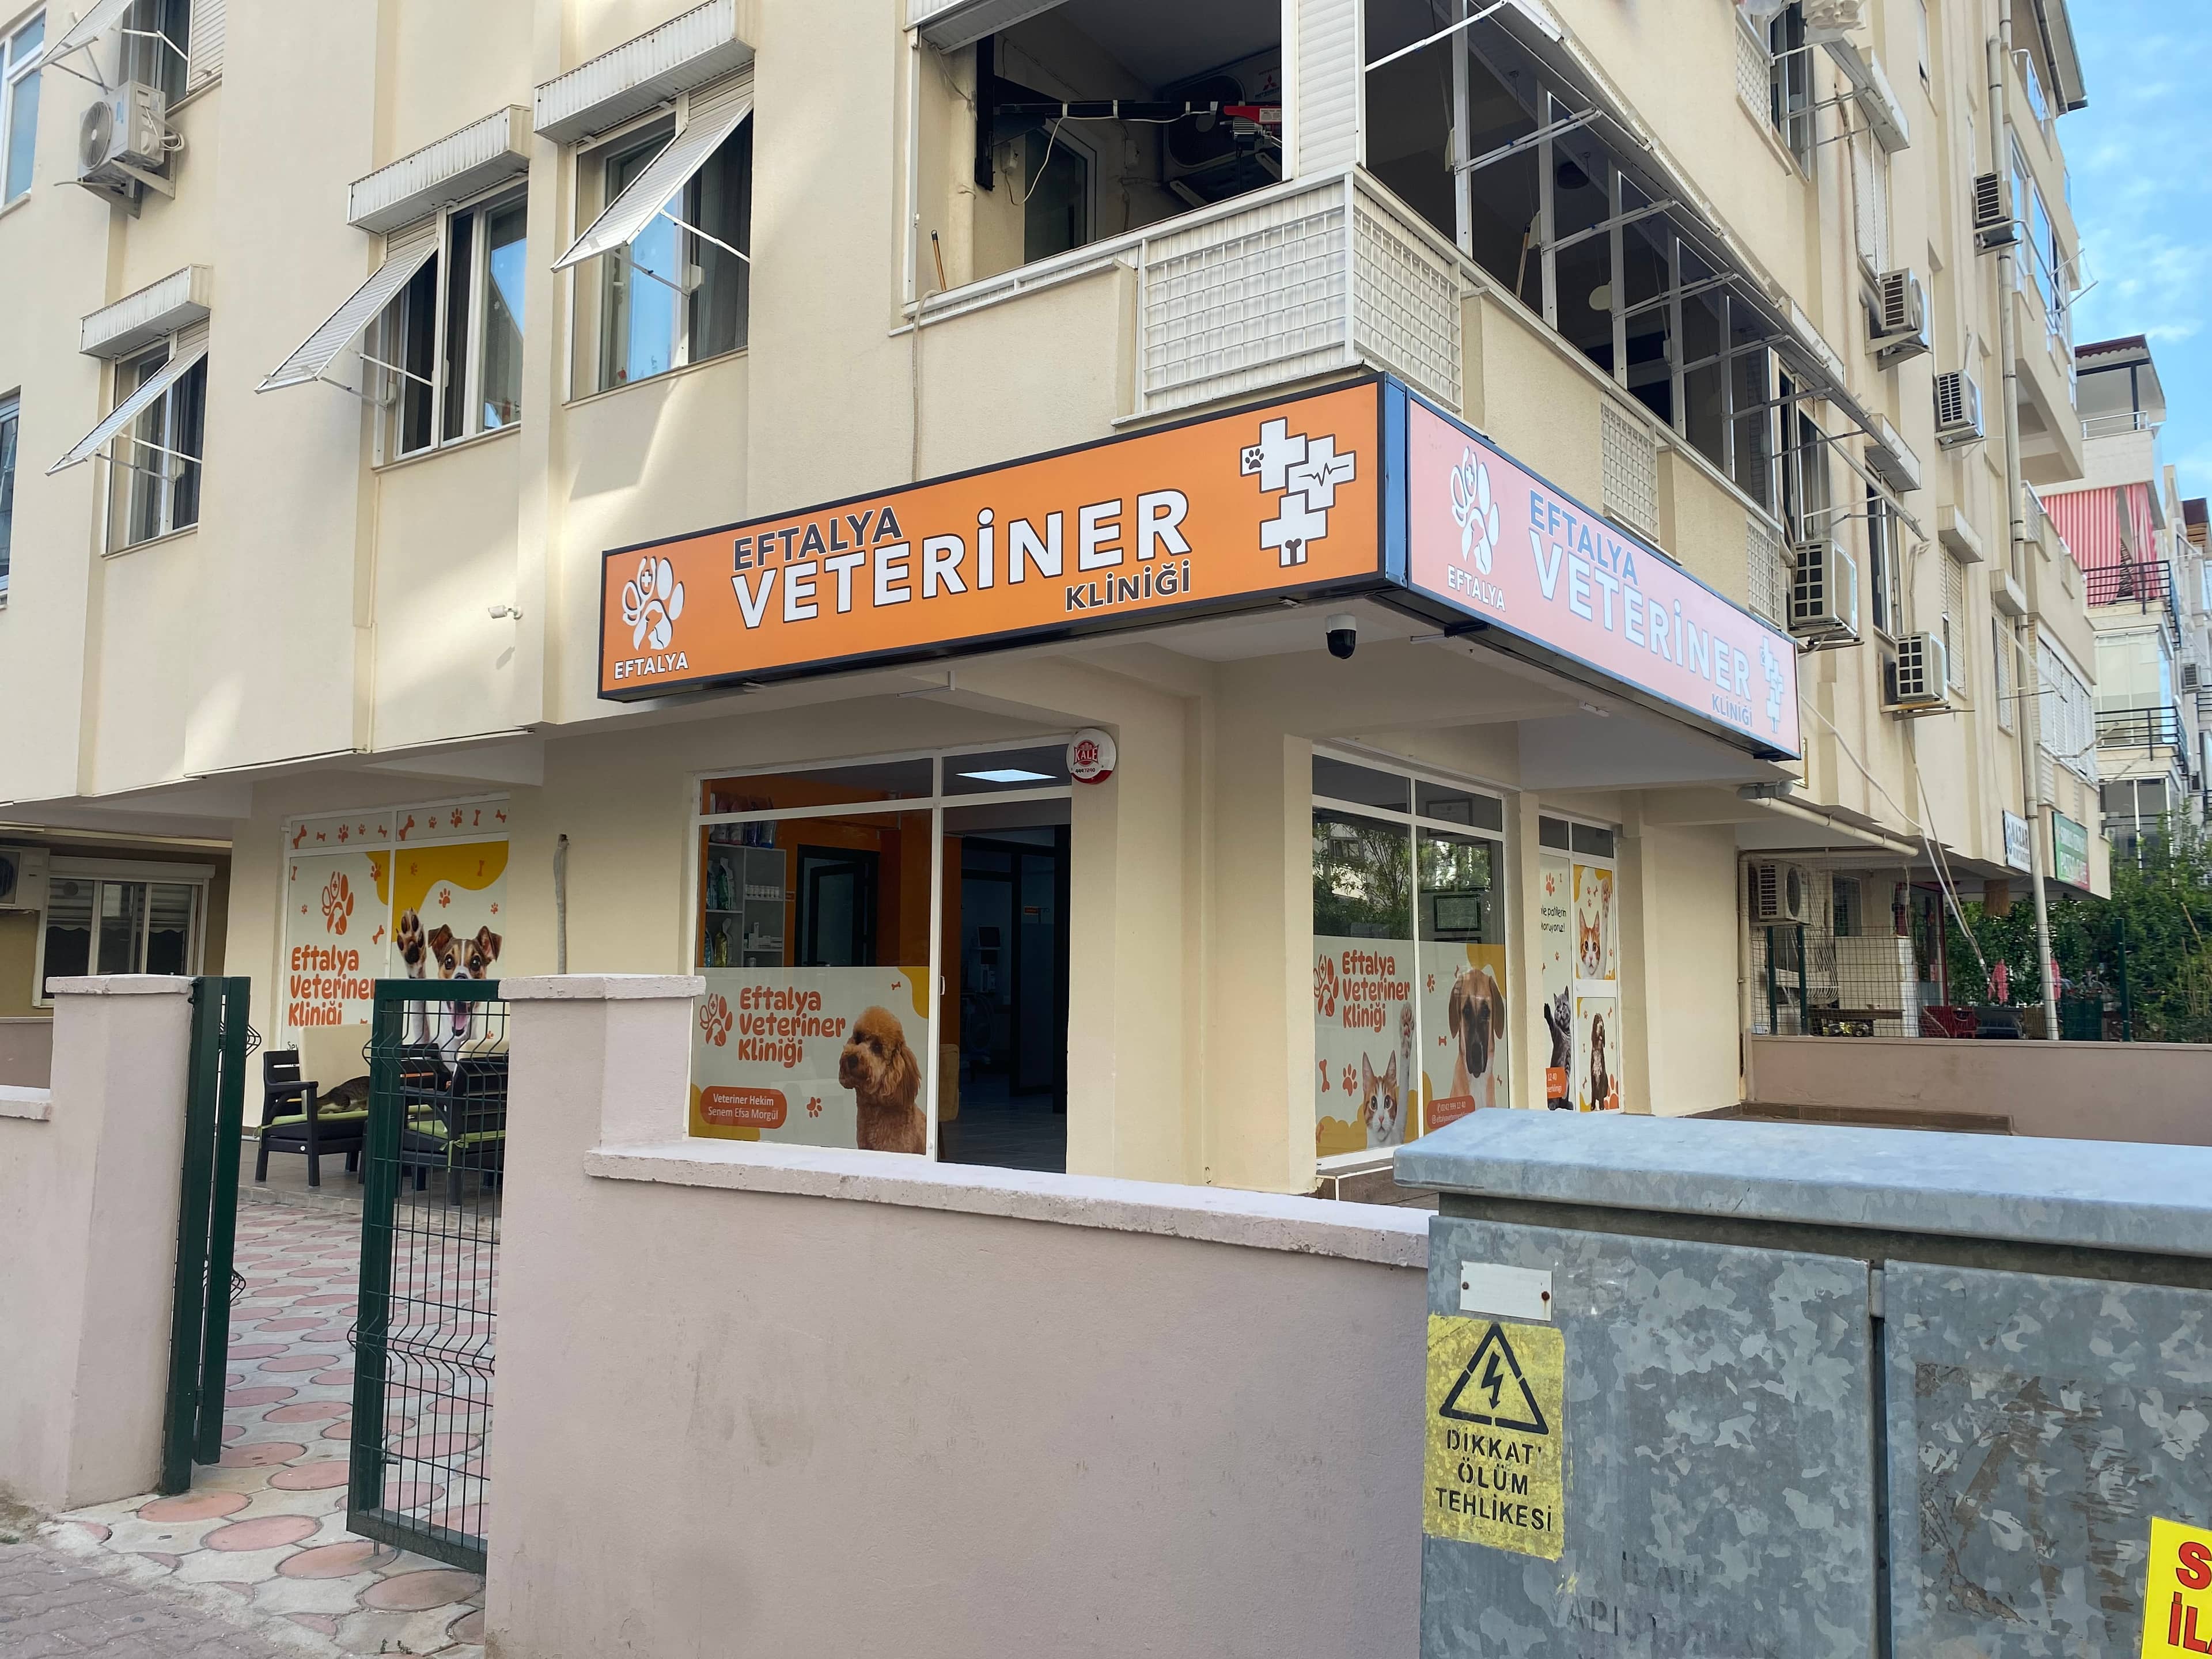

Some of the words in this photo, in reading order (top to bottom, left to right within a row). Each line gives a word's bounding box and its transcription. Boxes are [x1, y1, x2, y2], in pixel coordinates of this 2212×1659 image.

[734, 506, 903, 571] EFTALYA
[1530, 488, 1638, 586] EFTALYA
[732, 488, 1192, 629] VETERİNER
[1065, 560, 1191, 612] KLİNİĞİ
[1447, 564, 1506, 613] EFTALYA
[1528, 528, 1752, 701] VETERİNER
[613, 651, 689, 680] EFTALYA
[1711, 693, 1753, 728] KLİNİĞİ
[1075, 747, 1097, 763] KALE
[291, 945, 359, 976] Eftalya
[1342, 949, 1395, 980] Eftalya
[740, 986, 821, 1016] Eftalya
[1343, 978, 1410, 1001] Veteriner
[739, 1012, 846, 1037] Veteriner
[1343, 1002, 1386, 1033] Kliniği
[738, 1037, 803, 1069] Kliniği
[708, 1106, 733, 1117] Senem
[735, 1108, 749, 1118] Efsa
[751, 1109, 778, 1122] Morgül
[713, 1093, 748, 1104] Veteriner
[749, 1095, 774, 1106] Hekim
[1457, 1457, 1528, 1495] ÖLÜM
[1435, 1487, 1552, 1532] TEHLİKESİ
[2168, 1591, 2212, 1656] İL
